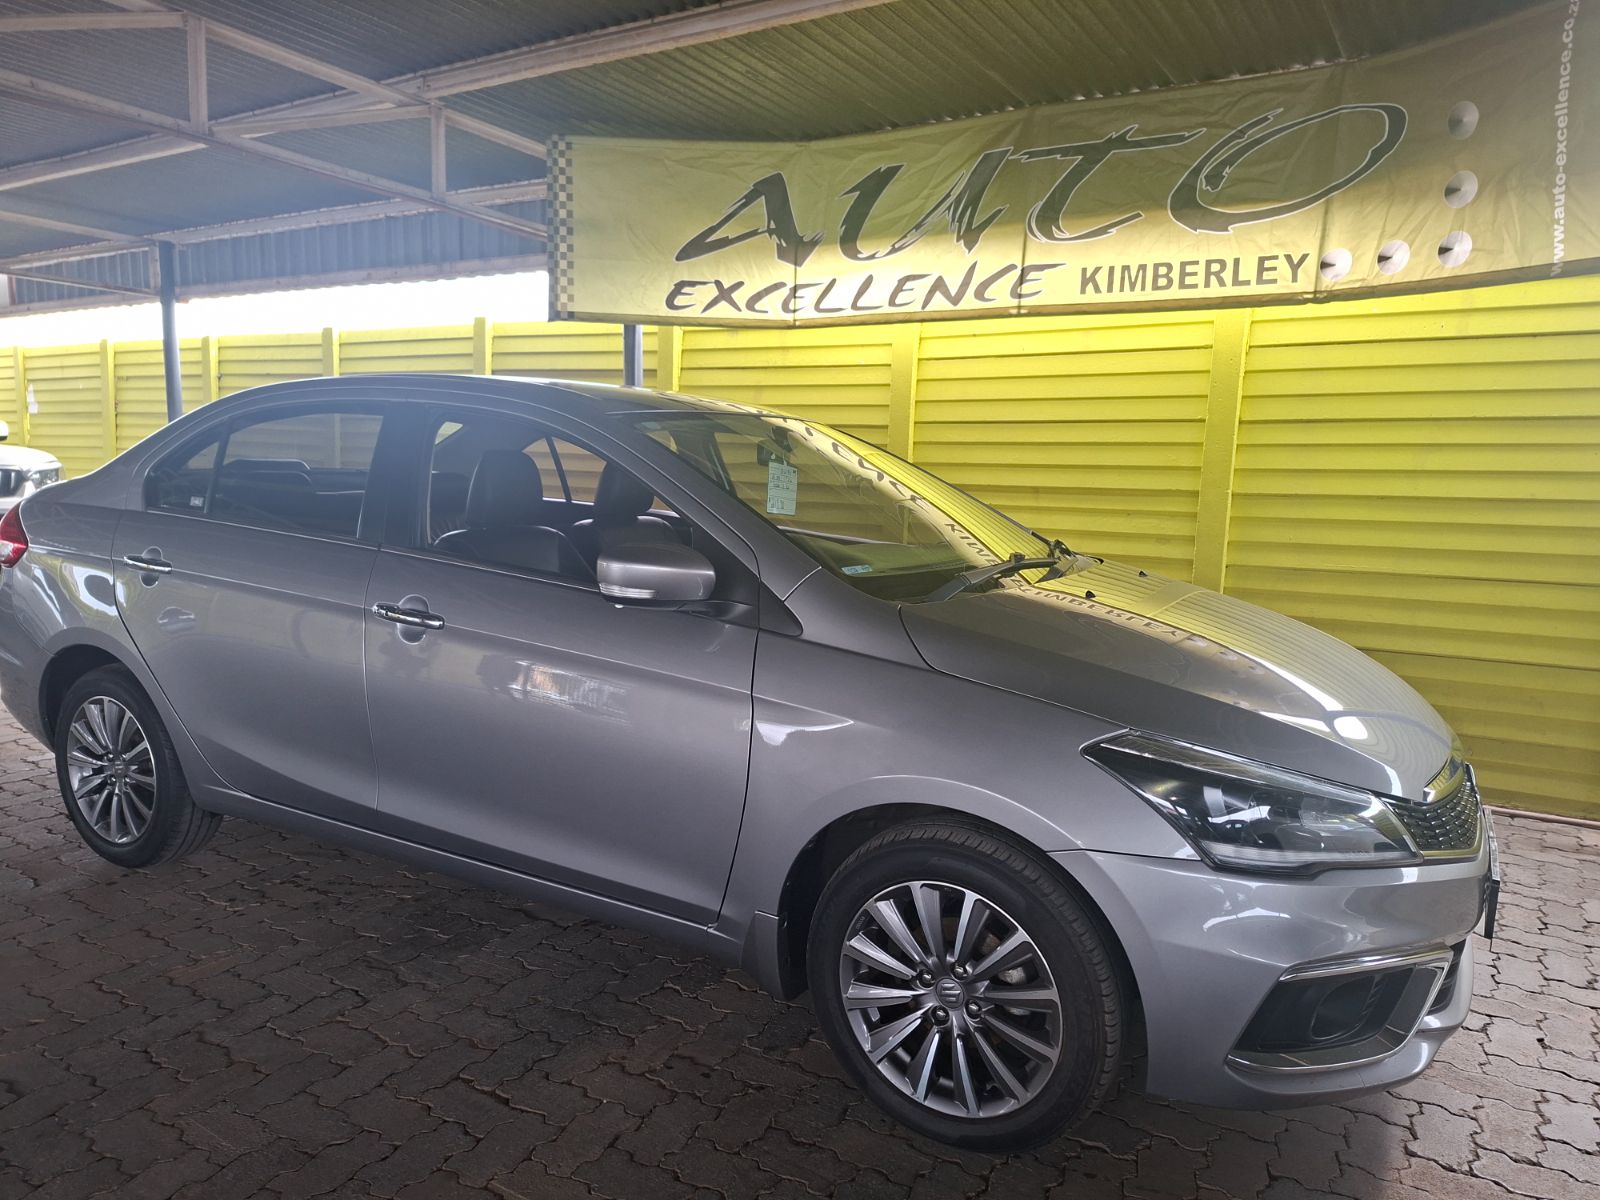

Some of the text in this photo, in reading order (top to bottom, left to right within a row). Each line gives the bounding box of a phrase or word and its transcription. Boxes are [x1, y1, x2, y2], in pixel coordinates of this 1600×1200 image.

[674, 102, 1409, 268] AUTO
[664, 252, 1311, 314] EXCELLENCE KIMBERLEY
